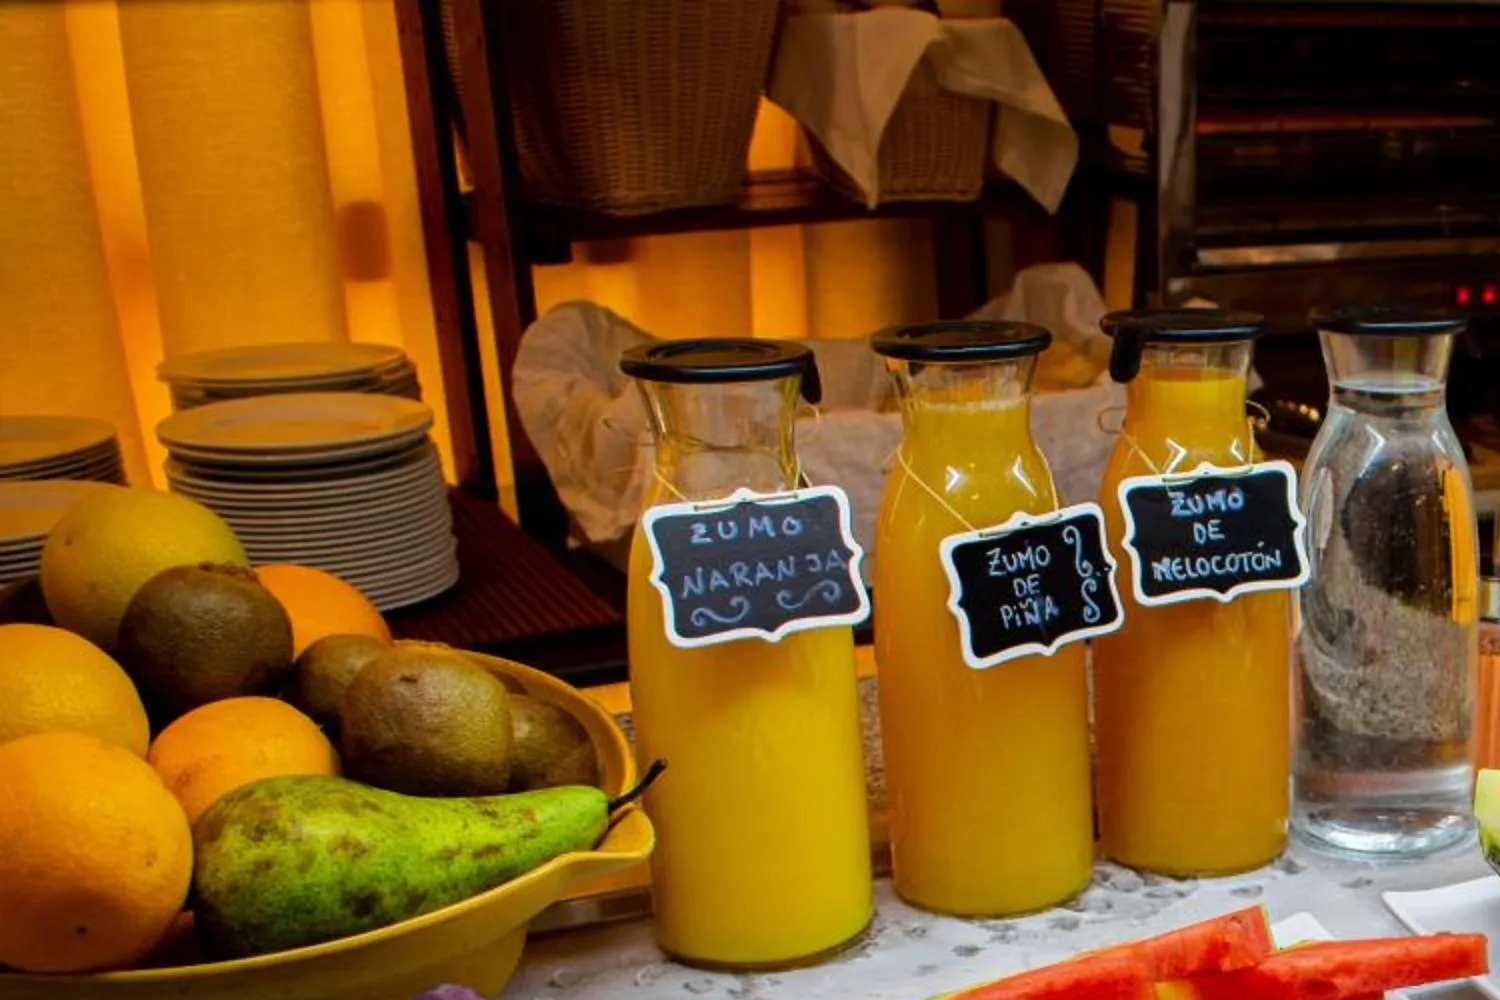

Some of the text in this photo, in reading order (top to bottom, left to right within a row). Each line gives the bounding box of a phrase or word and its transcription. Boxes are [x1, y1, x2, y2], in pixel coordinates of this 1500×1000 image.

[1168, 488, 1245, 517] ZUMO
[690, 516, 803, 544] ZUMO
[1193, 519, 1225, 544] DE
[682, 549, 846, 599] NARANJA
[986, 545, 1050, 576] ZUMO
[1013, 573, 1040, 597] DE
